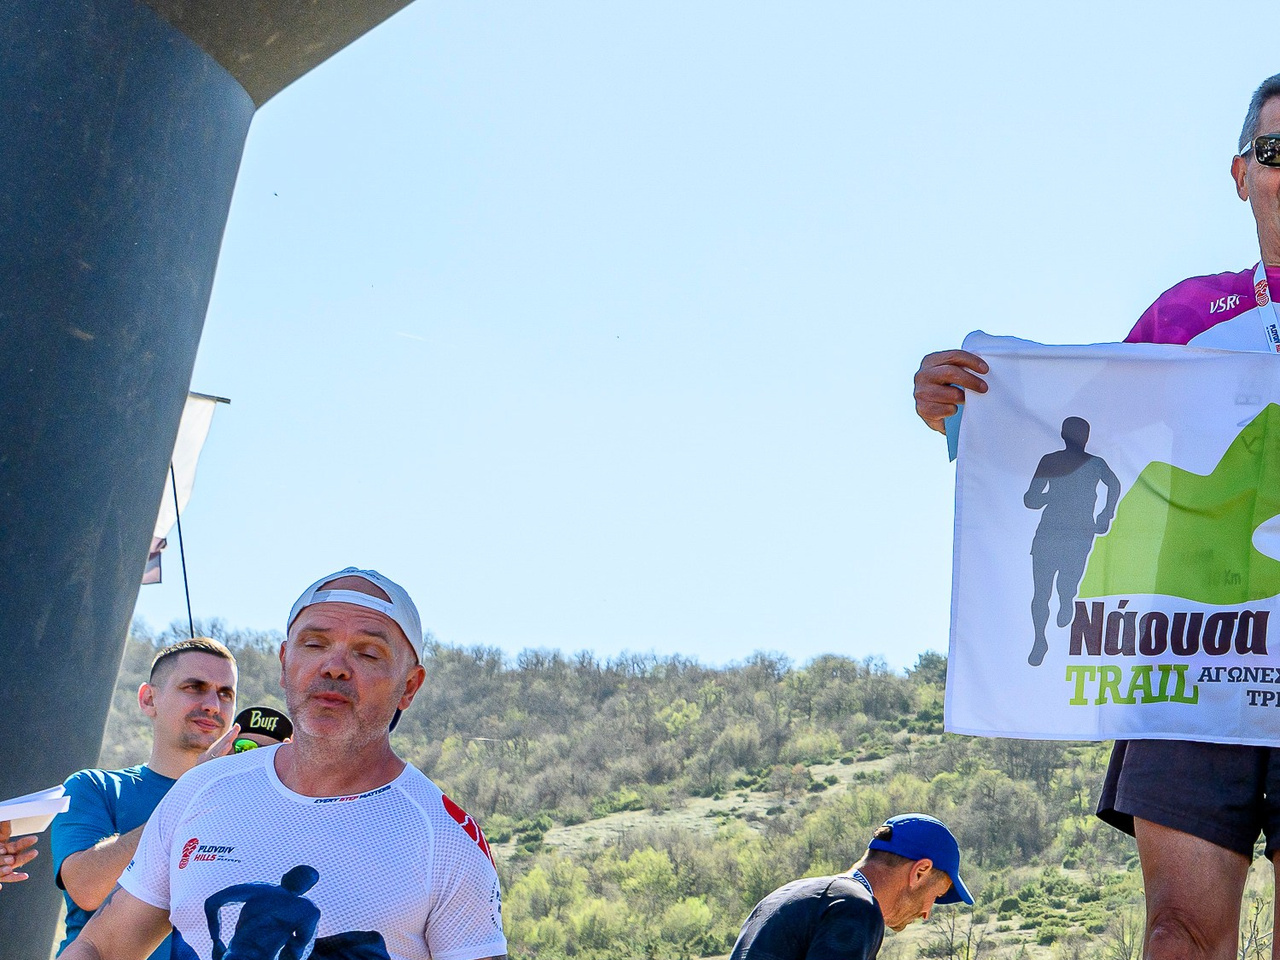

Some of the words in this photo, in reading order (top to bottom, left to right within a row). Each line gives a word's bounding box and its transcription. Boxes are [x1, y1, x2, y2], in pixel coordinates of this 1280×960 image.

[1068, 600, 1272, 658] Νάουσα
[1065, 664, 1199, 706] TRAIL
[193, 853, 217, 862] HILLS
[198, 845, 235, 854] PLOVDIV
